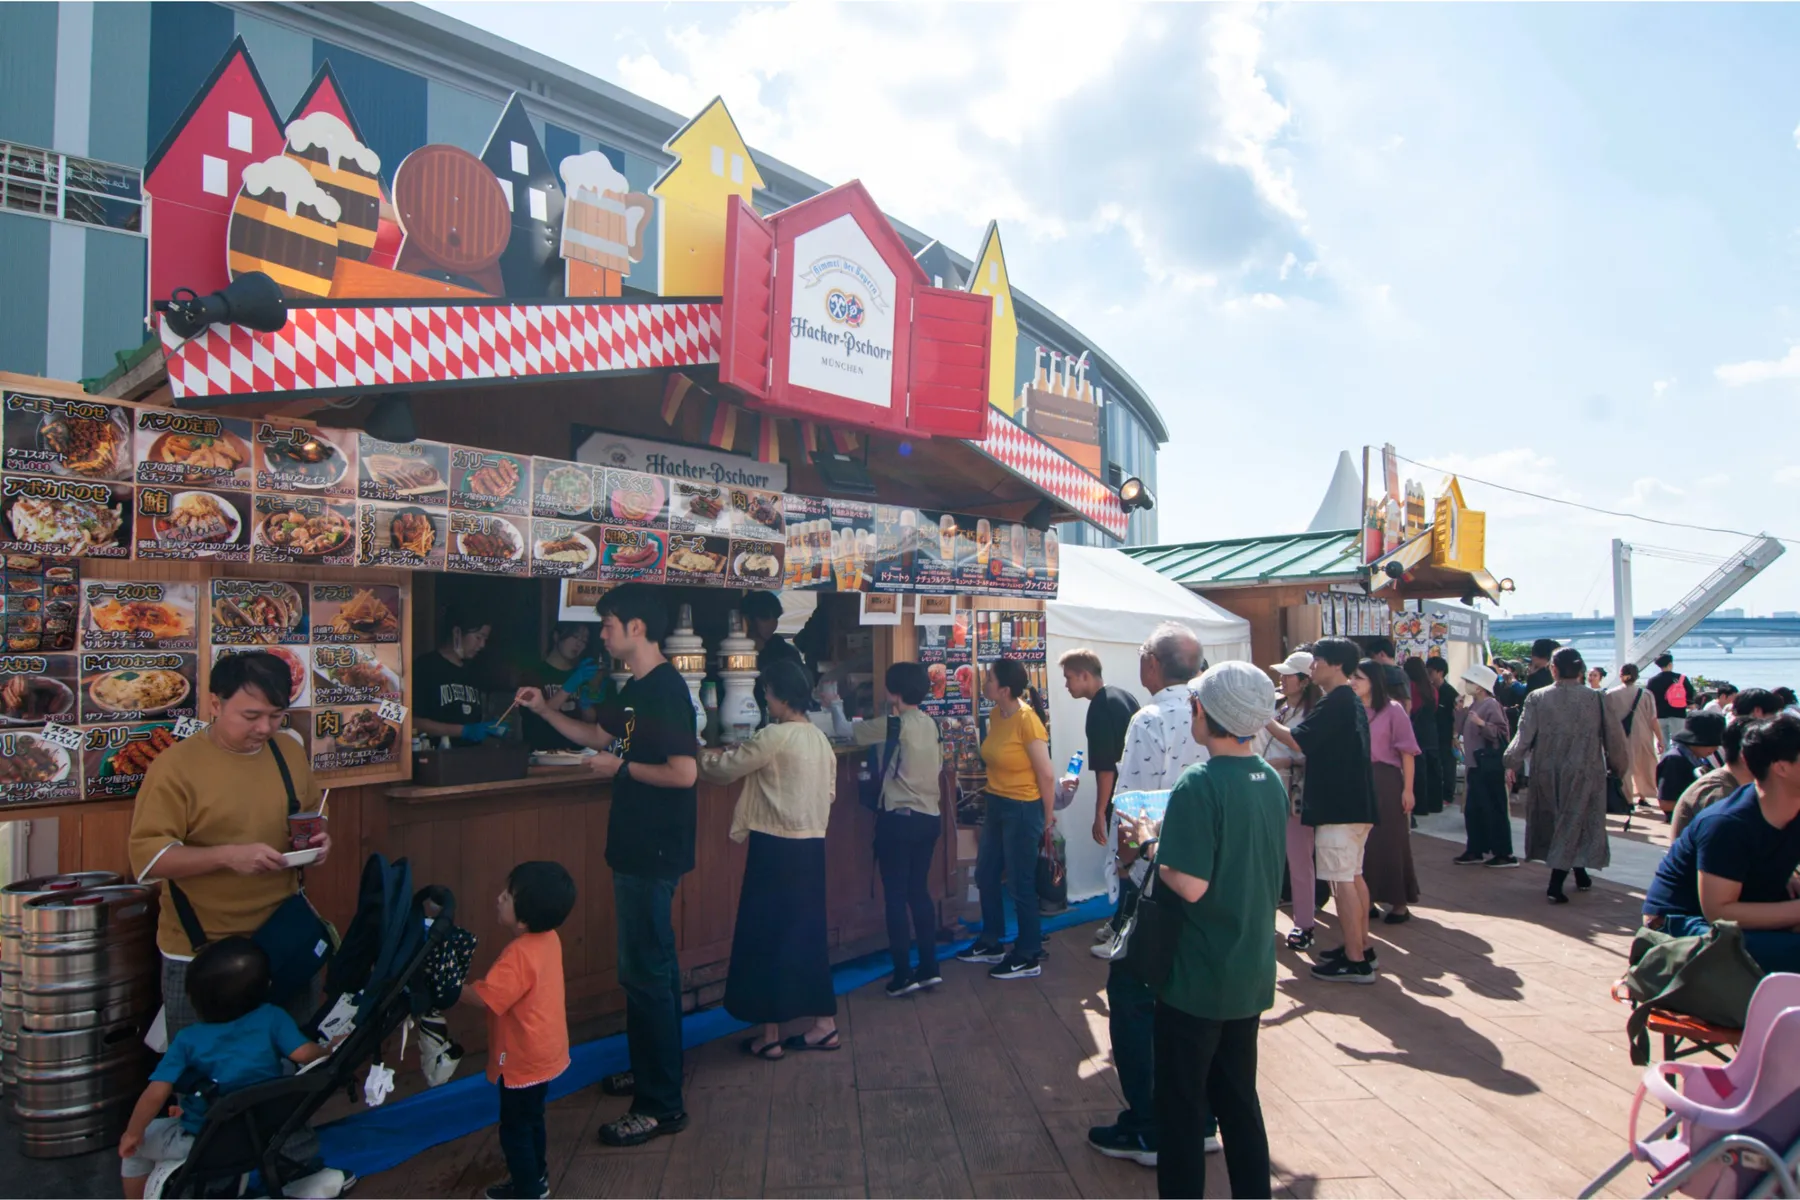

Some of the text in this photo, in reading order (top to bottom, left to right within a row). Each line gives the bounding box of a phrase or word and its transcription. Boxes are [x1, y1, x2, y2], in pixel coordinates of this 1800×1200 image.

[791, 317, 892, 360] Hacker-Pschorr
[821, 357, 864, 375] MÜNCHEN
[8, 396, 109, 420] タコミートのせ
[140, 413, 221, 436] パブの定番
[258, 425, 311, 446] ムール
[7, 447, 68, 461] タコスポテト
[452, 449, 498, 470] カリー
[646, 453, 769, 488] Hacker-Pschorr
[5, 478, 110, 503] アボカドのせ
[731, 490, 748, 512] 肉
[140, 488, 172, 516] 鮪
[1, 541, 71, 554] アボカドポテト
[669, 535, 706, 553] チーズ
[86, 583, 163, 600] チーズのせ
[215, 580, 283, 597] トルティーヤ
[0, 657, 44, 672] 大好き
[85, 654, 182, 670] ドイツのおつまみ
[315, 646, 356, 668] 海老
[315, 710, 342, 739] 肉
[85, 727, 151, 751] カリー
